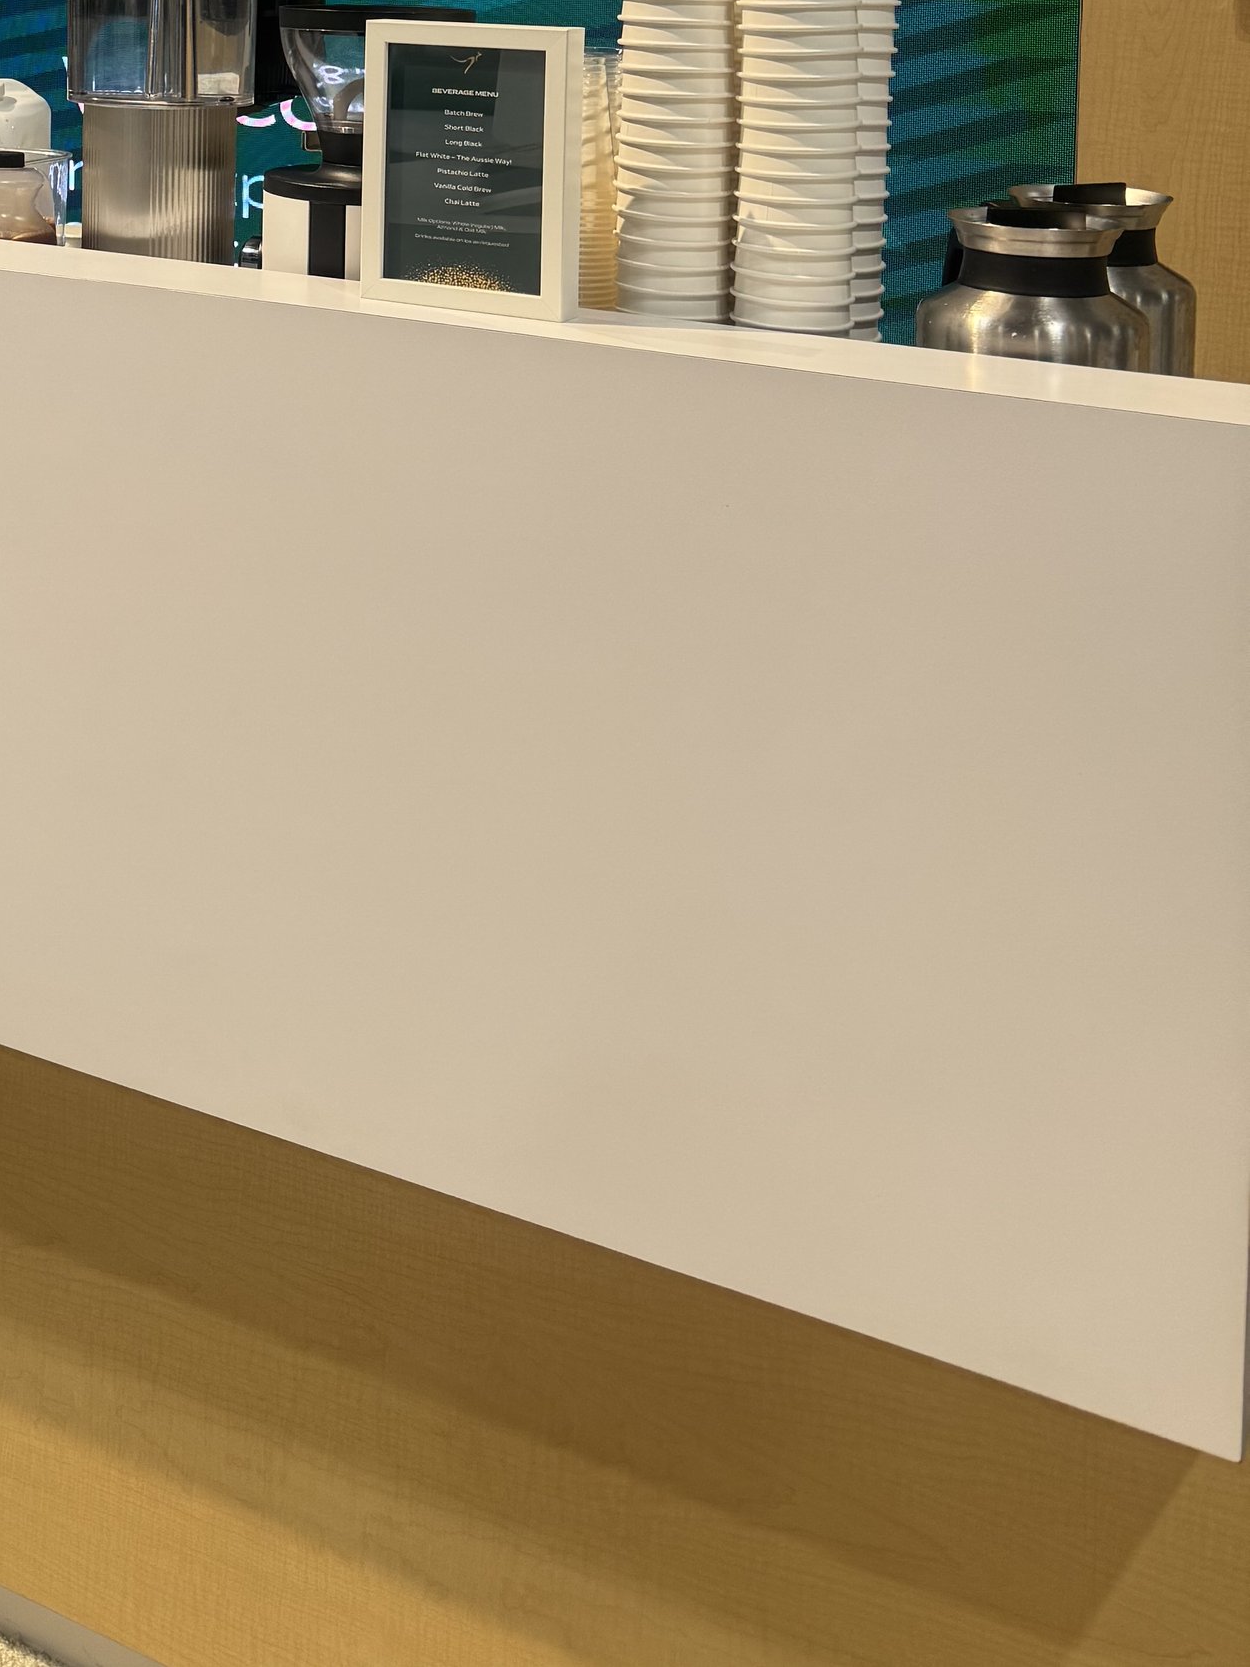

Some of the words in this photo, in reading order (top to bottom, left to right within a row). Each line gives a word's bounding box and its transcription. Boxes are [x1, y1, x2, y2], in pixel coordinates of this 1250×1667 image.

[432, 88, 474, 96] BEVERAGE
[445, 139, 462, 147] Long
[495, 158, 512, 166] Way!
[437, 168, 468, 176] Pistachio
[470, 170, 489, 178] Latte
[434, 182, 456, 190] Vanilla
[457, 184, 473, 192] Cold
[461, 199, 480, 207] Latte
